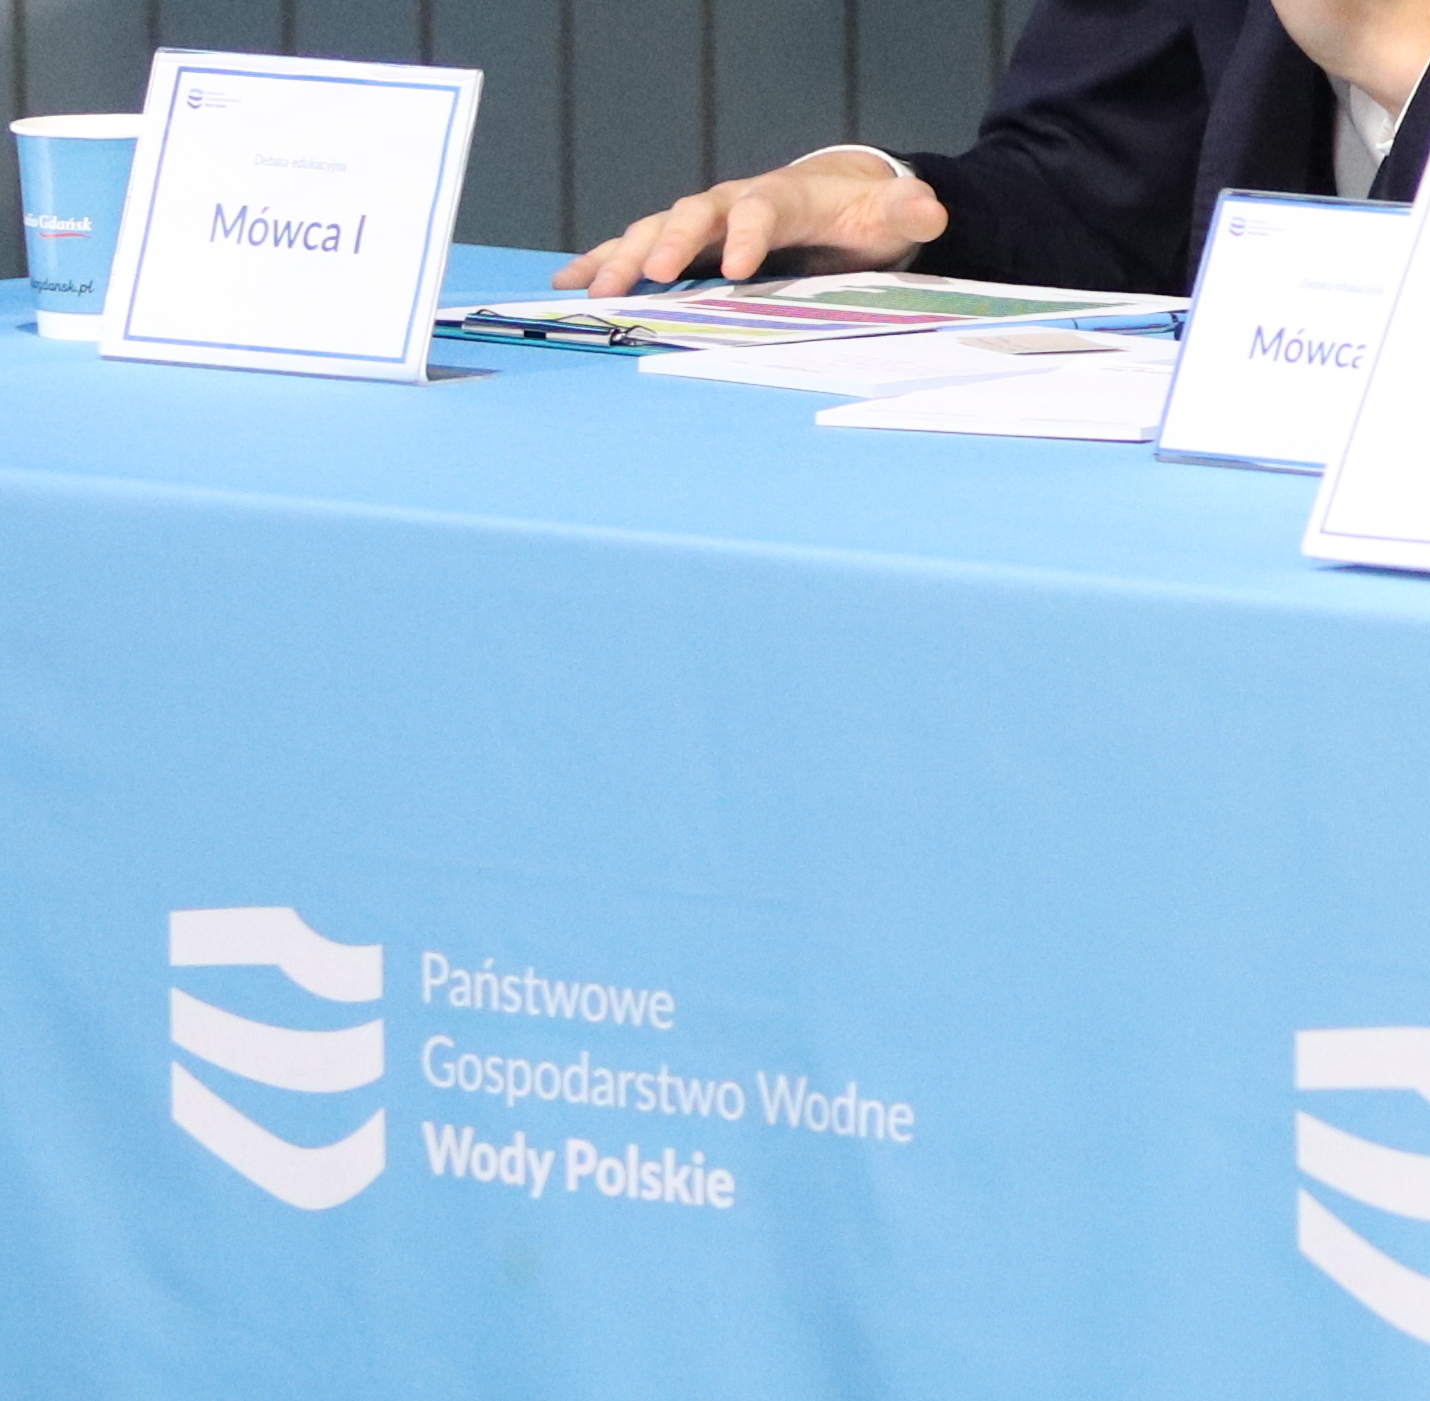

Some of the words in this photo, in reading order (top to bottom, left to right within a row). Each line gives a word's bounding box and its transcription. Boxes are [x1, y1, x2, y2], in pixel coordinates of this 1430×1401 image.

[209, 202, 342, 253] Mówca
[352, 213, 367, 255] I
[421, 950, 677, 1031] Państwowe
[421, 1034, 747, 1121] Gospodarstwo
[755, 1071, 916, 1144] Wodne
[421, 1121, 557, 1199] Wody
[564, 1138, 737, 1210] Polskie
